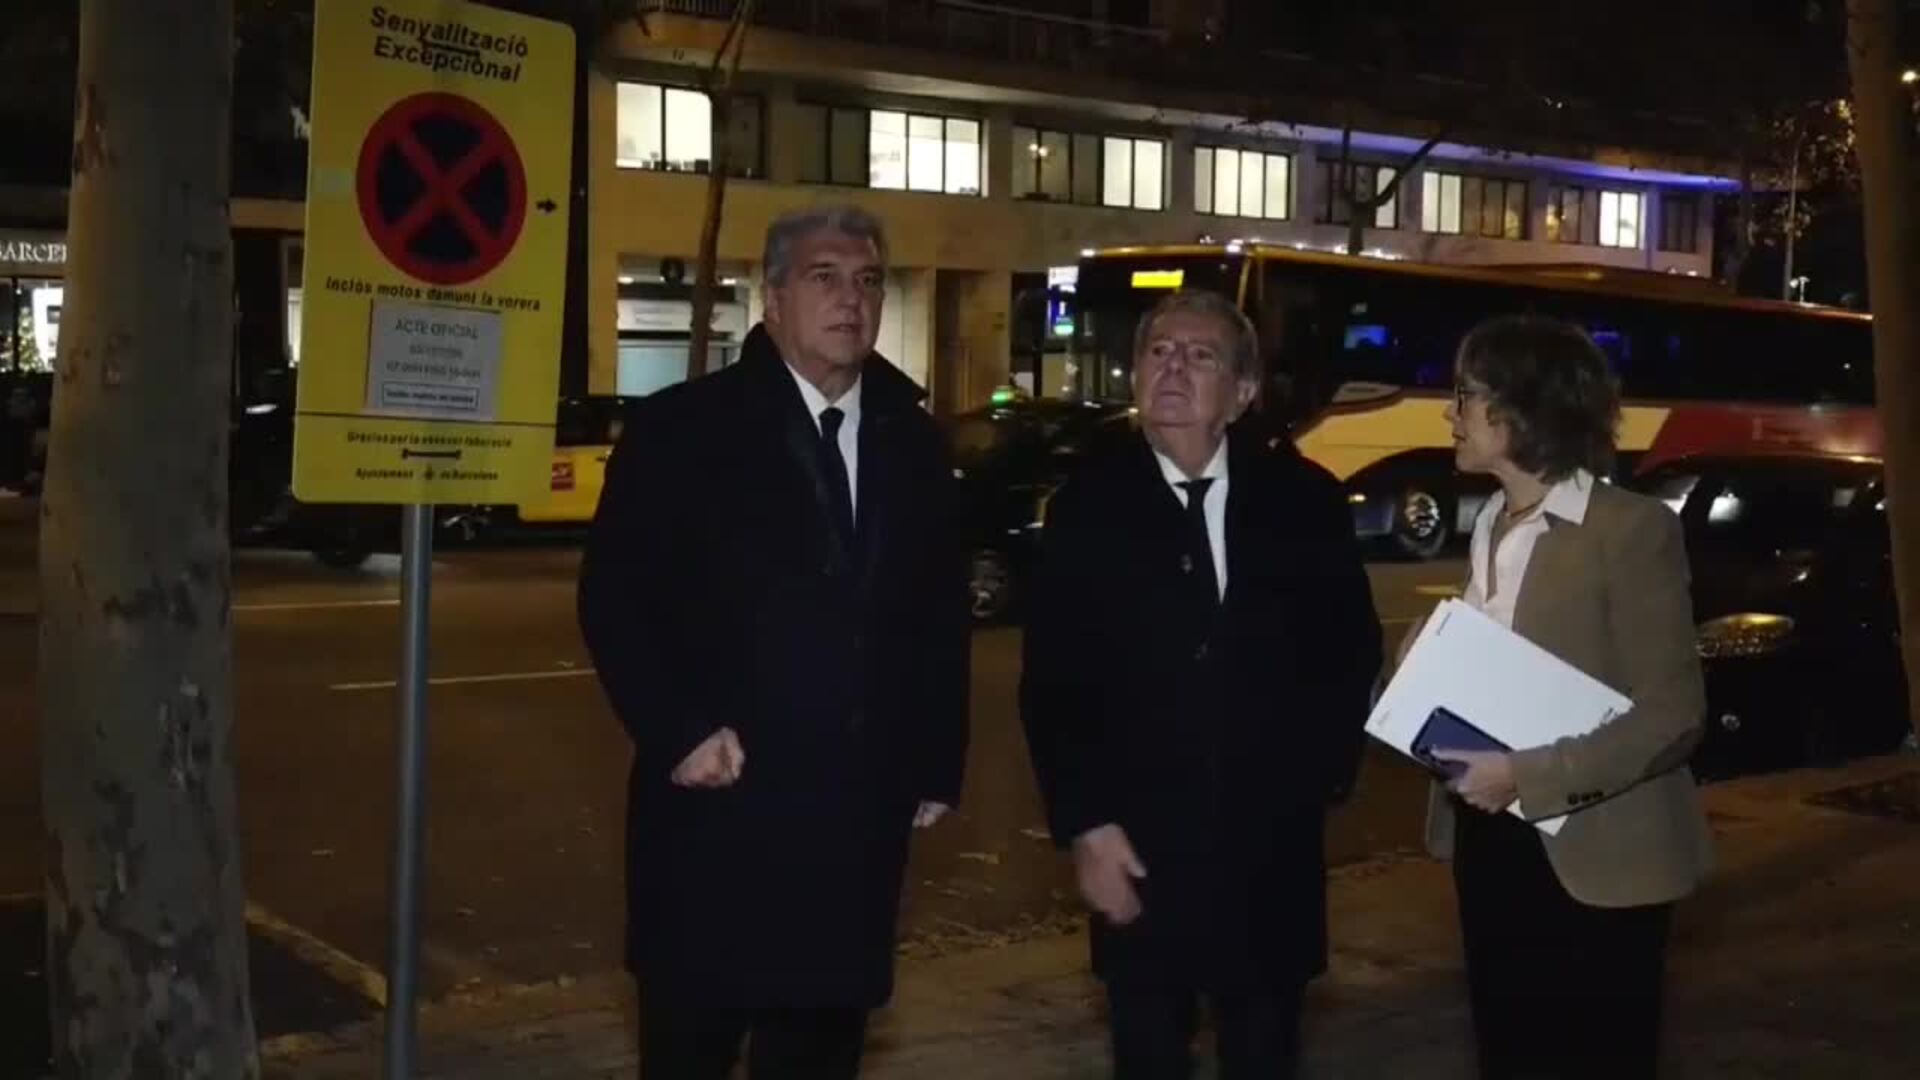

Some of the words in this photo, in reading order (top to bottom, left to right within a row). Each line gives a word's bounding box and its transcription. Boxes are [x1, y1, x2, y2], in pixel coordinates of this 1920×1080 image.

[370, 6, 529, 57] Senyalització
[373, 35, 521, 82] Excepcional
[377, 284, 421, 299] motos
[481, 289, 494, 306] la
[497, 297, 541, 311] vorera
[395, 318, 429, 335] ACTE
[430, 322, 479, 340] OFICIAL
